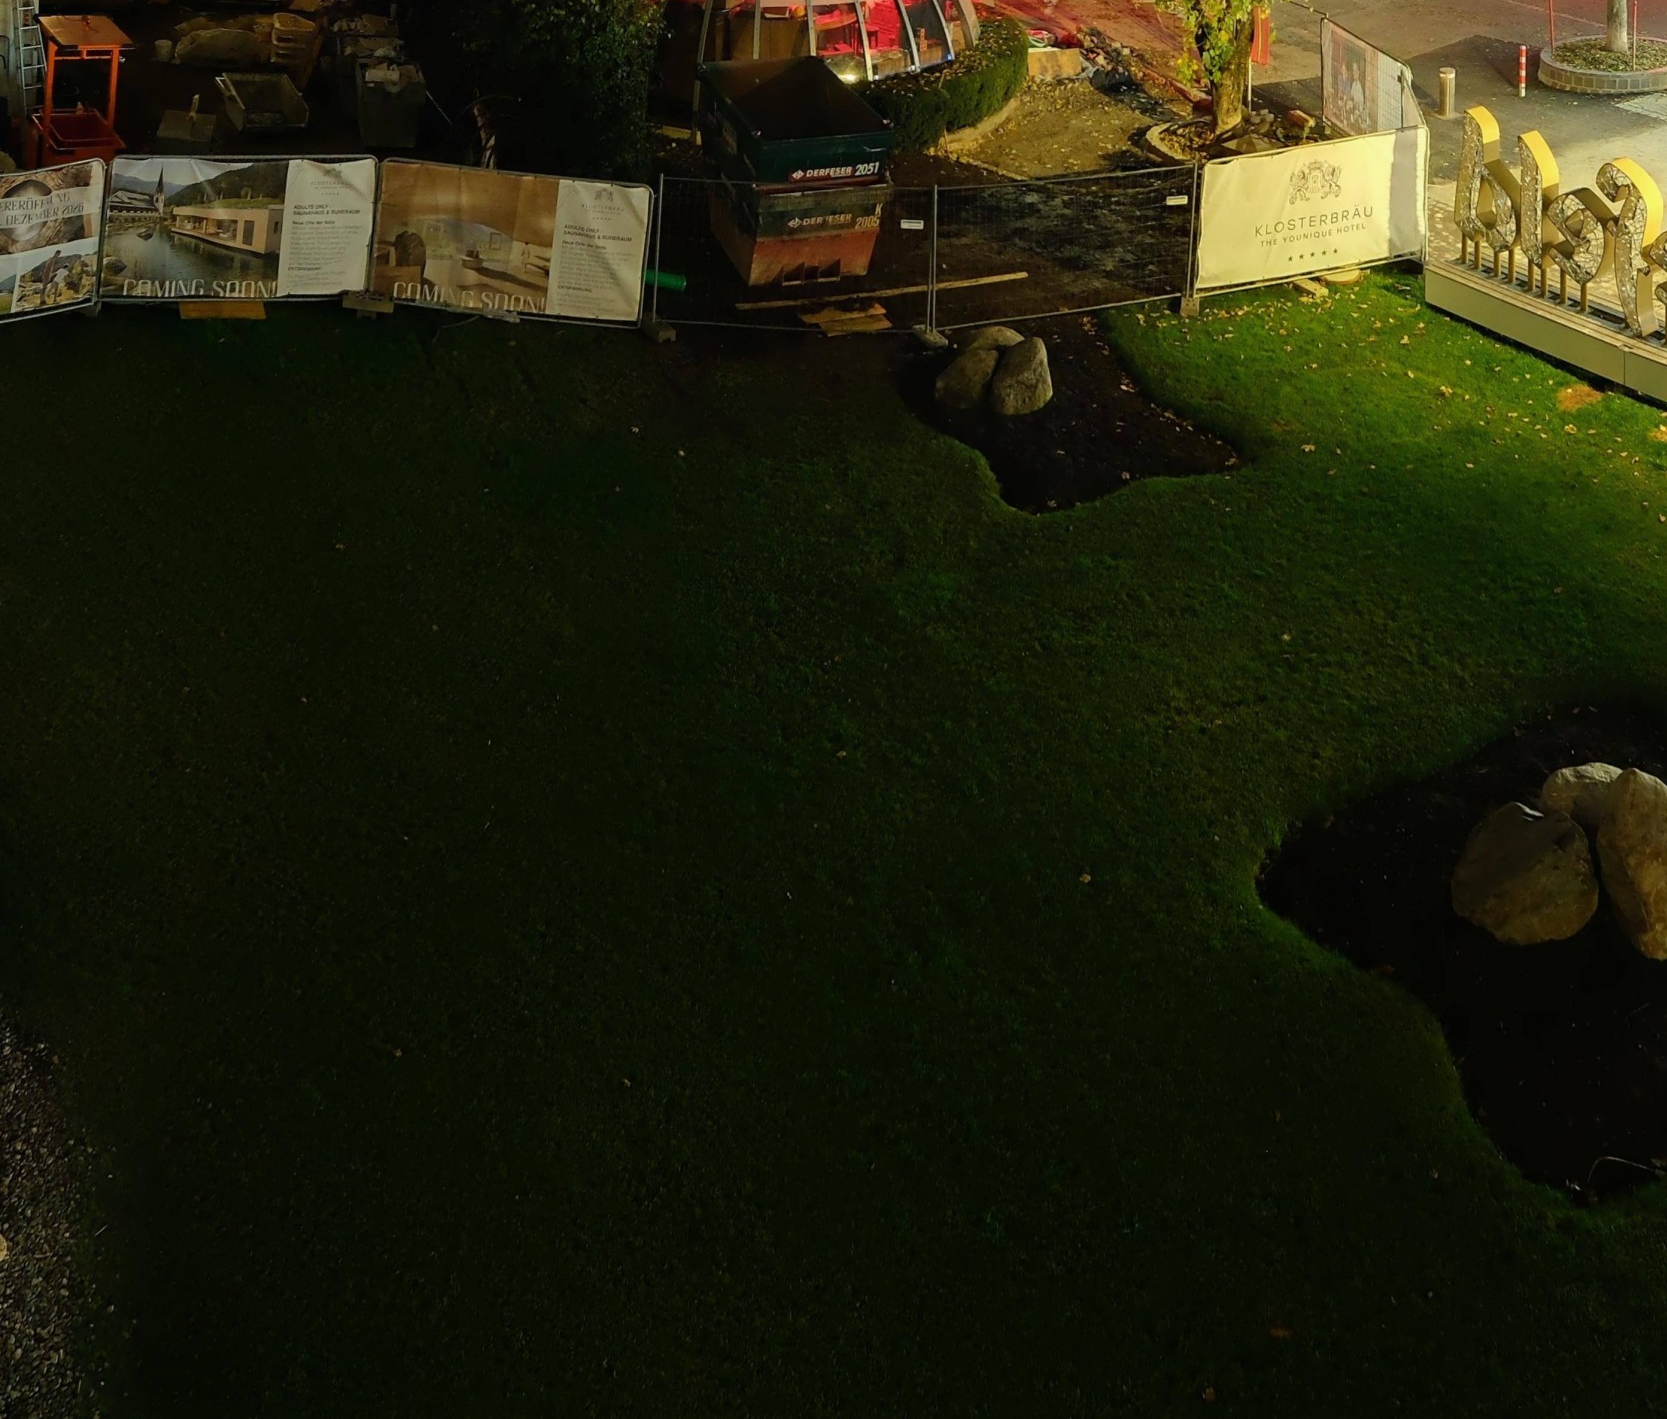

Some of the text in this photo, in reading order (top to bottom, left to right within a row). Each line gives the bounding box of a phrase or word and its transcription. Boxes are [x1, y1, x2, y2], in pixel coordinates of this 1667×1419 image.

[805, 162, 880, 178] DERFESER 2051
[802, 214, 852, 227] DERESER
[1255, 204, 1374, 238] KLOSTERBRÄU
[1260, 223, 1367, 248] THE YOUNIQUE HOTEL
[123, 279, 204, 297] COMING
